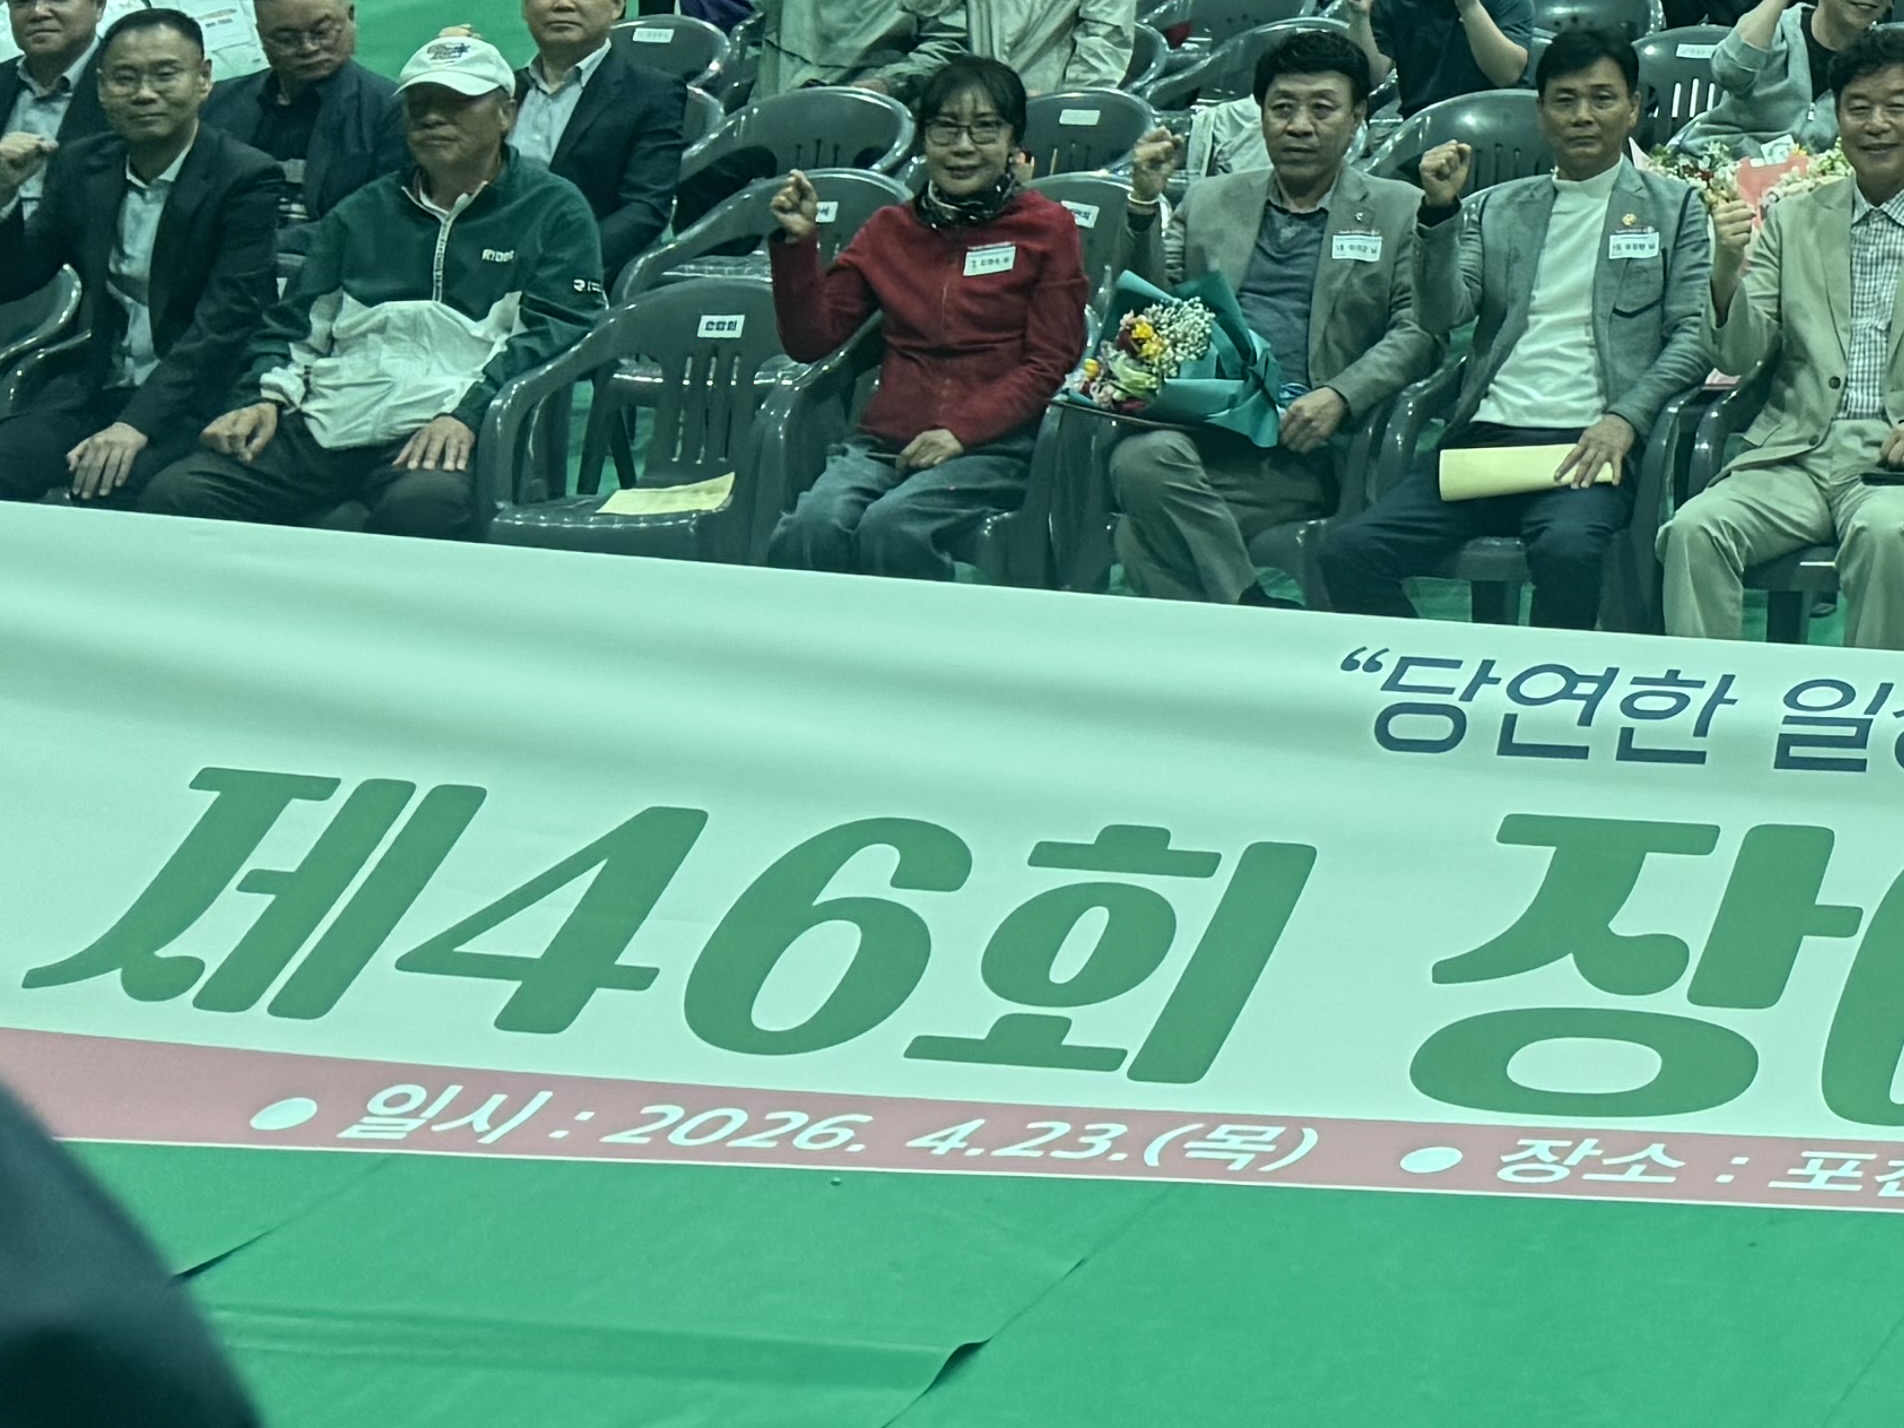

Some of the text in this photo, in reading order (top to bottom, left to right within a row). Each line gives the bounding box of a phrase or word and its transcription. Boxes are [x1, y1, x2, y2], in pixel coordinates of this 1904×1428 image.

[1340, 646, 1738, 766] “당연한
[22, 766, 1318, 1085] 제46회
[337, 1084, 543, 1144] 일시
[600, 1101, 868, 1156] 2026.
[905, 1117, 1322, 1174] 4.23.(목)
[1495, 1138, 1688, 1186] 장소
